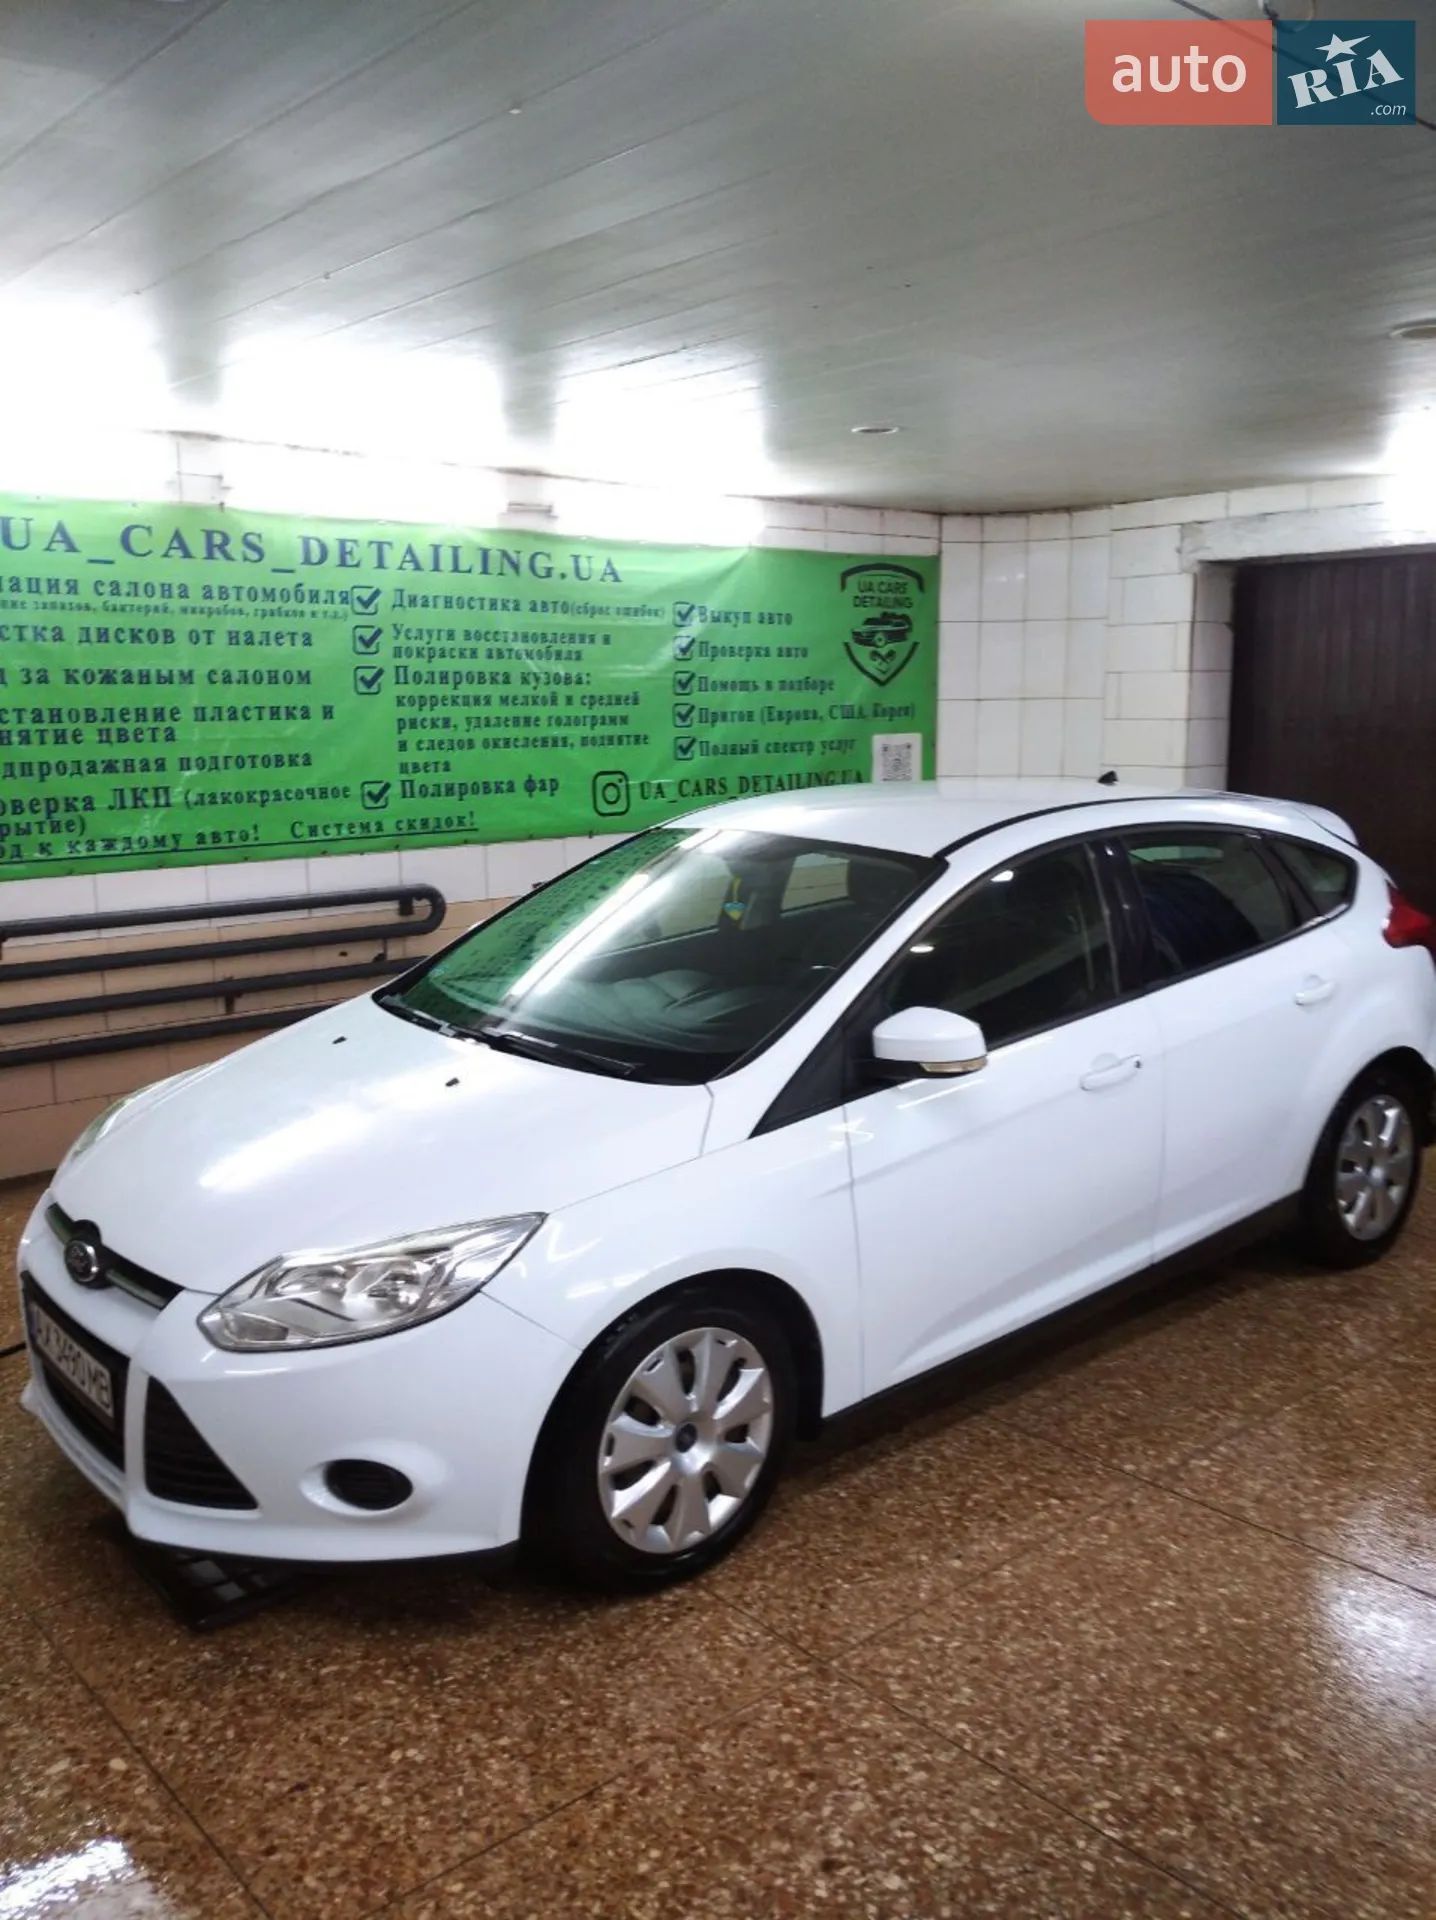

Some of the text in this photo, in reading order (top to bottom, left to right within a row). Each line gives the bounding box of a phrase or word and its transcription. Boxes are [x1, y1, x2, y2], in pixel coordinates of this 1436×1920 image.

[0, 515, 623, 583] UA_CARS_DETAILING.UA
[93, 578, 190, 600] салона
[202, 583, 350, 605] автомобиля
[391, 588, 521, 612] Диагностика
[698, 605, 793, 628] Выкуп авто
[78, 626, 175, 645] дисков
[188, 628, 216, 646] от
[227, 627, 314, 647] налета
[391, 624, 612, 646] Услуги восстановления и
[392, 645, 583, 663] покраски автомобиля
[698, 641, 809, 662] Проверка авто
[20, 667, 50, 686] за
[63, 667, 196, 686] кожаным
[206, 668, 313, 686] салоном
[394, 665, 592, 690] Полировка кузова:
[698, 676, 759, 695] Помощь
[778, 676, 835, 695] подборе
[396, 690, 641, 712] коррекция мелкой и средней
[0, 703, 335, 725] становление пластика и
[396, 714, 630, 735] риски, удаление голограмм
[698, 707, 755, 728] Пригон
[97, 724, 178, 745] цвета
[398, 733, 650, 753] и следов окисления, поднятие
[698, 739, 760, 757] Полный
[765, 739, 815, 756] спектр
[179, 752, 314, 773] подготовка
[399, 758, 452, 776] цвета
[400, 773, 560, 801] Полировка фар
[108, 786, 174, 812] ЛКП
[184, 785, 351, 810] (лакокрасочное
[38, 841, 53, 856] к
[67, 832, 183, 856] каждому
[195, 823, 261, 846] авто!
[290, 817, 384, 839] Система
[395, 811, 475, 831] скидок!
